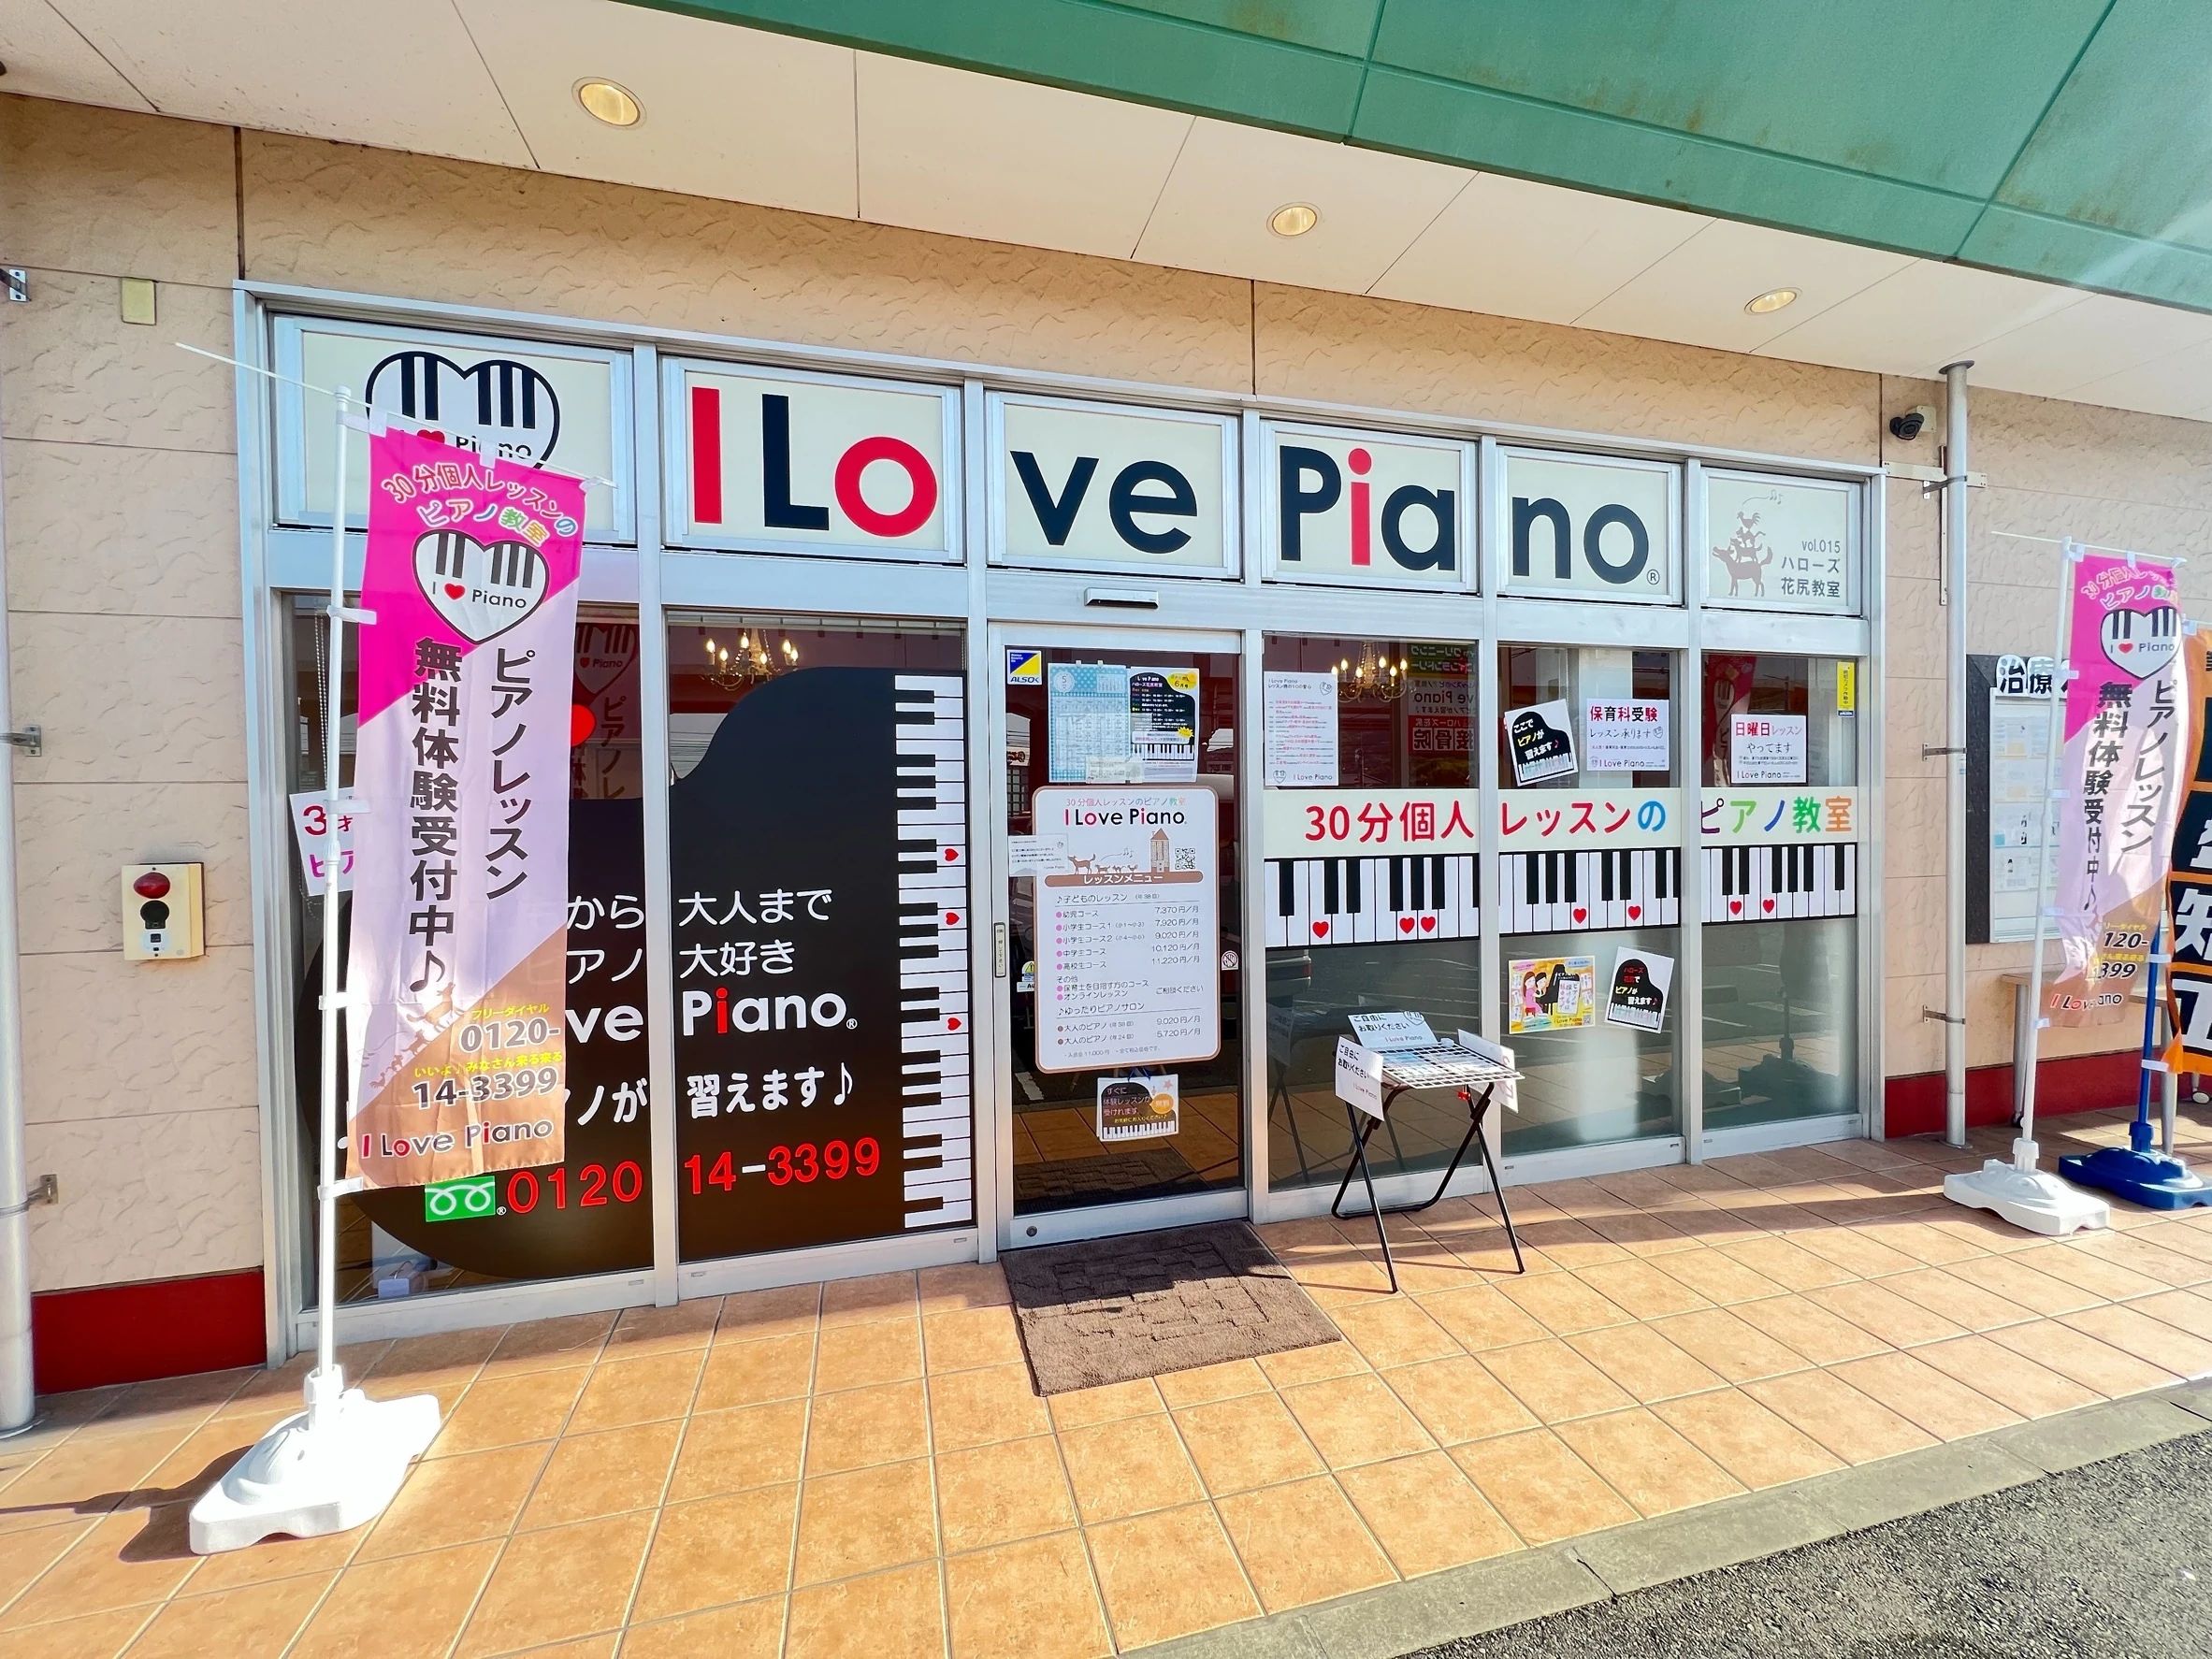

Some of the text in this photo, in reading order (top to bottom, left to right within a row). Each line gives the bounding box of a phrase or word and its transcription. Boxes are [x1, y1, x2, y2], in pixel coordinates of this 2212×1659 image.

[692, 386, 722, 524] I
[382, 463, 577, 536] 30分個人レッスンの
[417, 498, 550, 546] ピアノ教室
[1781, 556, 1841, 573] ハローズ
[1781, 577, 1841, 599] 花尻教室
[471, 588, 527, 609] Piano
[2138, 642, 2175, 653] Piano
[1590, 706, 1657, 722] 保育科受験
[1513, 718, 1534, 734] ここで
[1517, 729, 1545, 746] ピアノが
[1747, 743, 1792, 753] やってます
[484, 648, 536, 900] ピアノレッスン
[2120, 679, 2178, 853] ピアノレッスン
[1075, 809, 1123, 826] Love
[1083, 874, 1164, 885] レッスンメニュー
[678, 888, 833, 927] 大人まで
[679, 939, 796, 979] 大好き
[1063, 990, 1129, 1001] オンラインレッスン
[1615, 986, 1639, 994] ピアノが
[471, 1003, 550, 1020] フリーダイヤル
[458, 1017, 560, 1053] 0120-
[1064, 1022, 1106, 1031] 大人のピアノ
[1358, 1023, 1410, 1032] お取りください
[1064, 1035, 1106, 1045] 大人のピアノ
[412, 1067, 558, 1110] 14-3399
[361, 1119, 554, 1158] I Love Piano
[506, 1137, 881, 1214] 0120 14-3399
